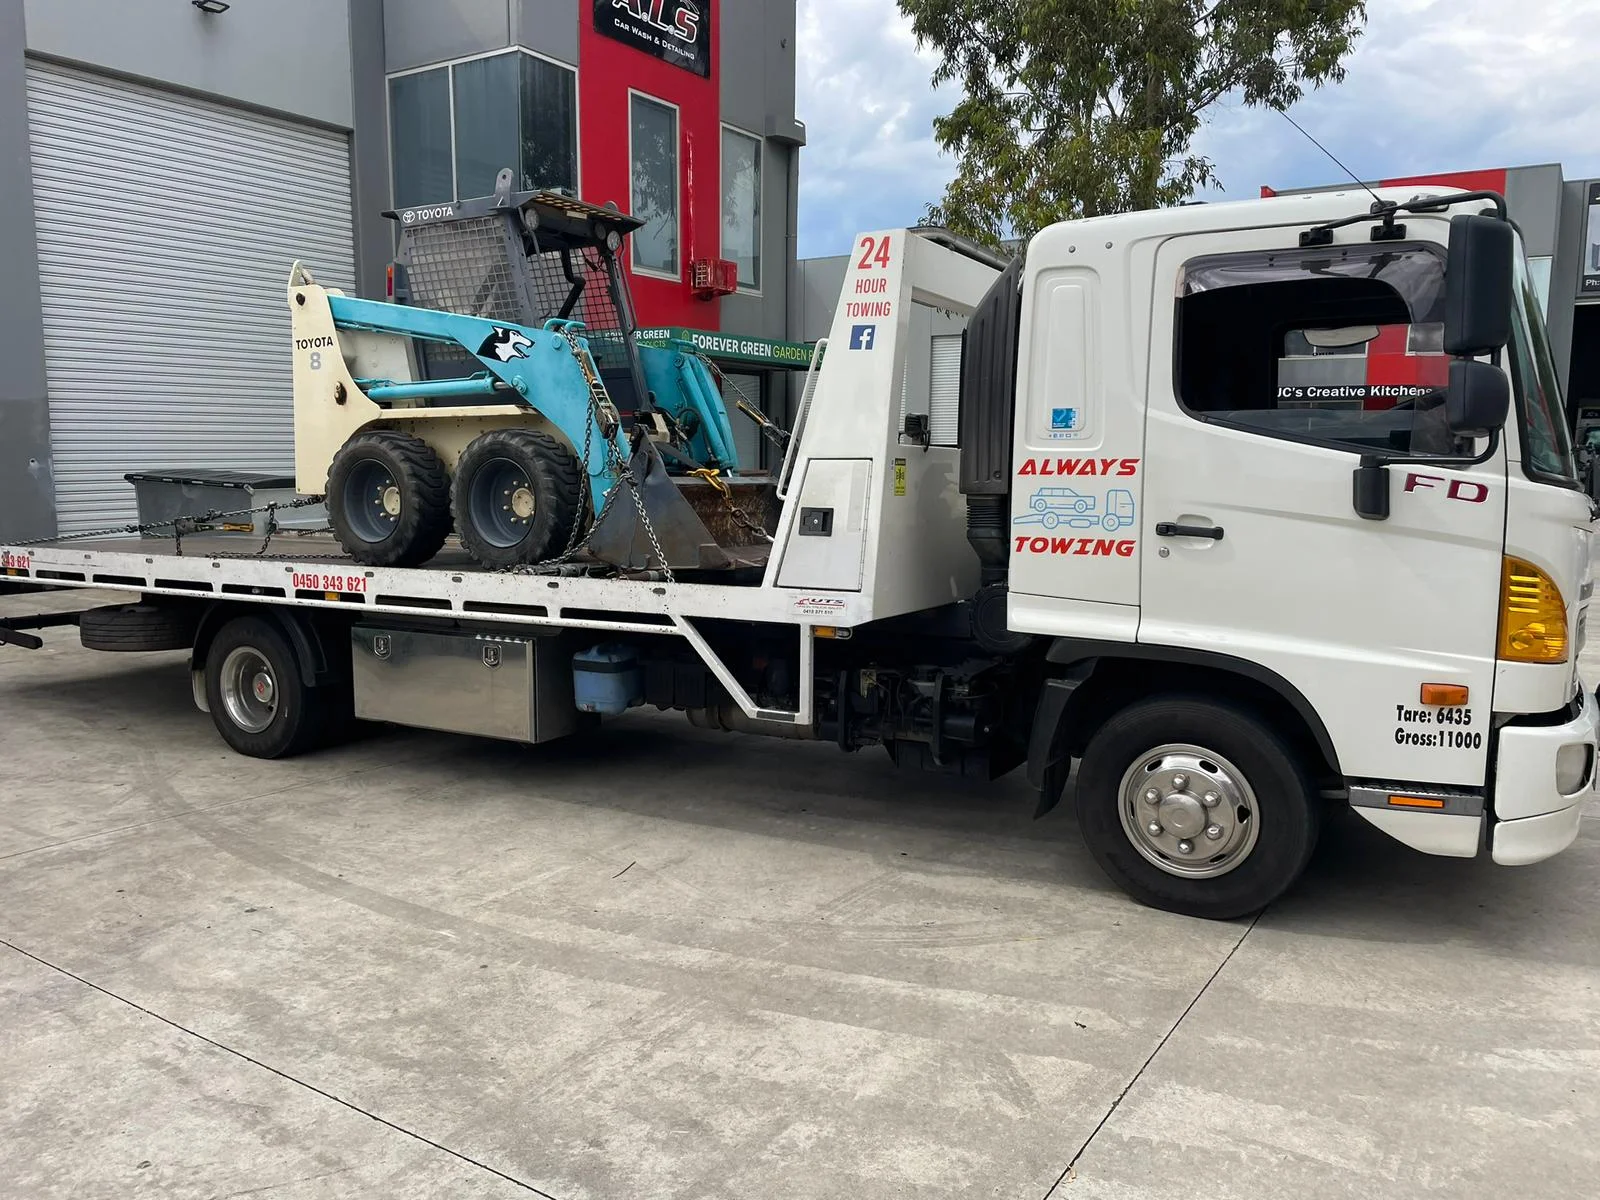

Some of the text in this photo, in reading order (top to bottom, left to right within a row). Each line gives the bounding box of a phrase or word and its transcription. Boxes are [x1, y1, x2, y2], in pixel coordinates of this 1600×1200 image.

[614, 19, 695, 60] CAR WASH & DETAILING
[416, 206, 453, 220] TOYOTA
[857, 235, 890, 269] 24
[855, 278, 887, 293] HOUR
[846, 301, 891, 318] TOWING
[296, 335, 333, 350] TOYOTA
[643, 329, 670, 339] GREEN
[692, 334, 739, 353] FOREVER
[740, 340, 772, 357] GREEN
[772, 345, 806, 361] GARDEN
[310, 351, 321, 370] 8
[1277, 386, 1303, 398] JC's
[1306, 386, 1366, 397] Creative
[1017, 458, 1140, 476] ALWAYS
[1404, 473, 1489, 503] FD
[1015, 536, 1136, 557] TOWING
[17, 555, 30, 569] 621
[292, 572, 367, 592] 0450 343 621
[1396, 704, 1472, 725] Tare: 6435
